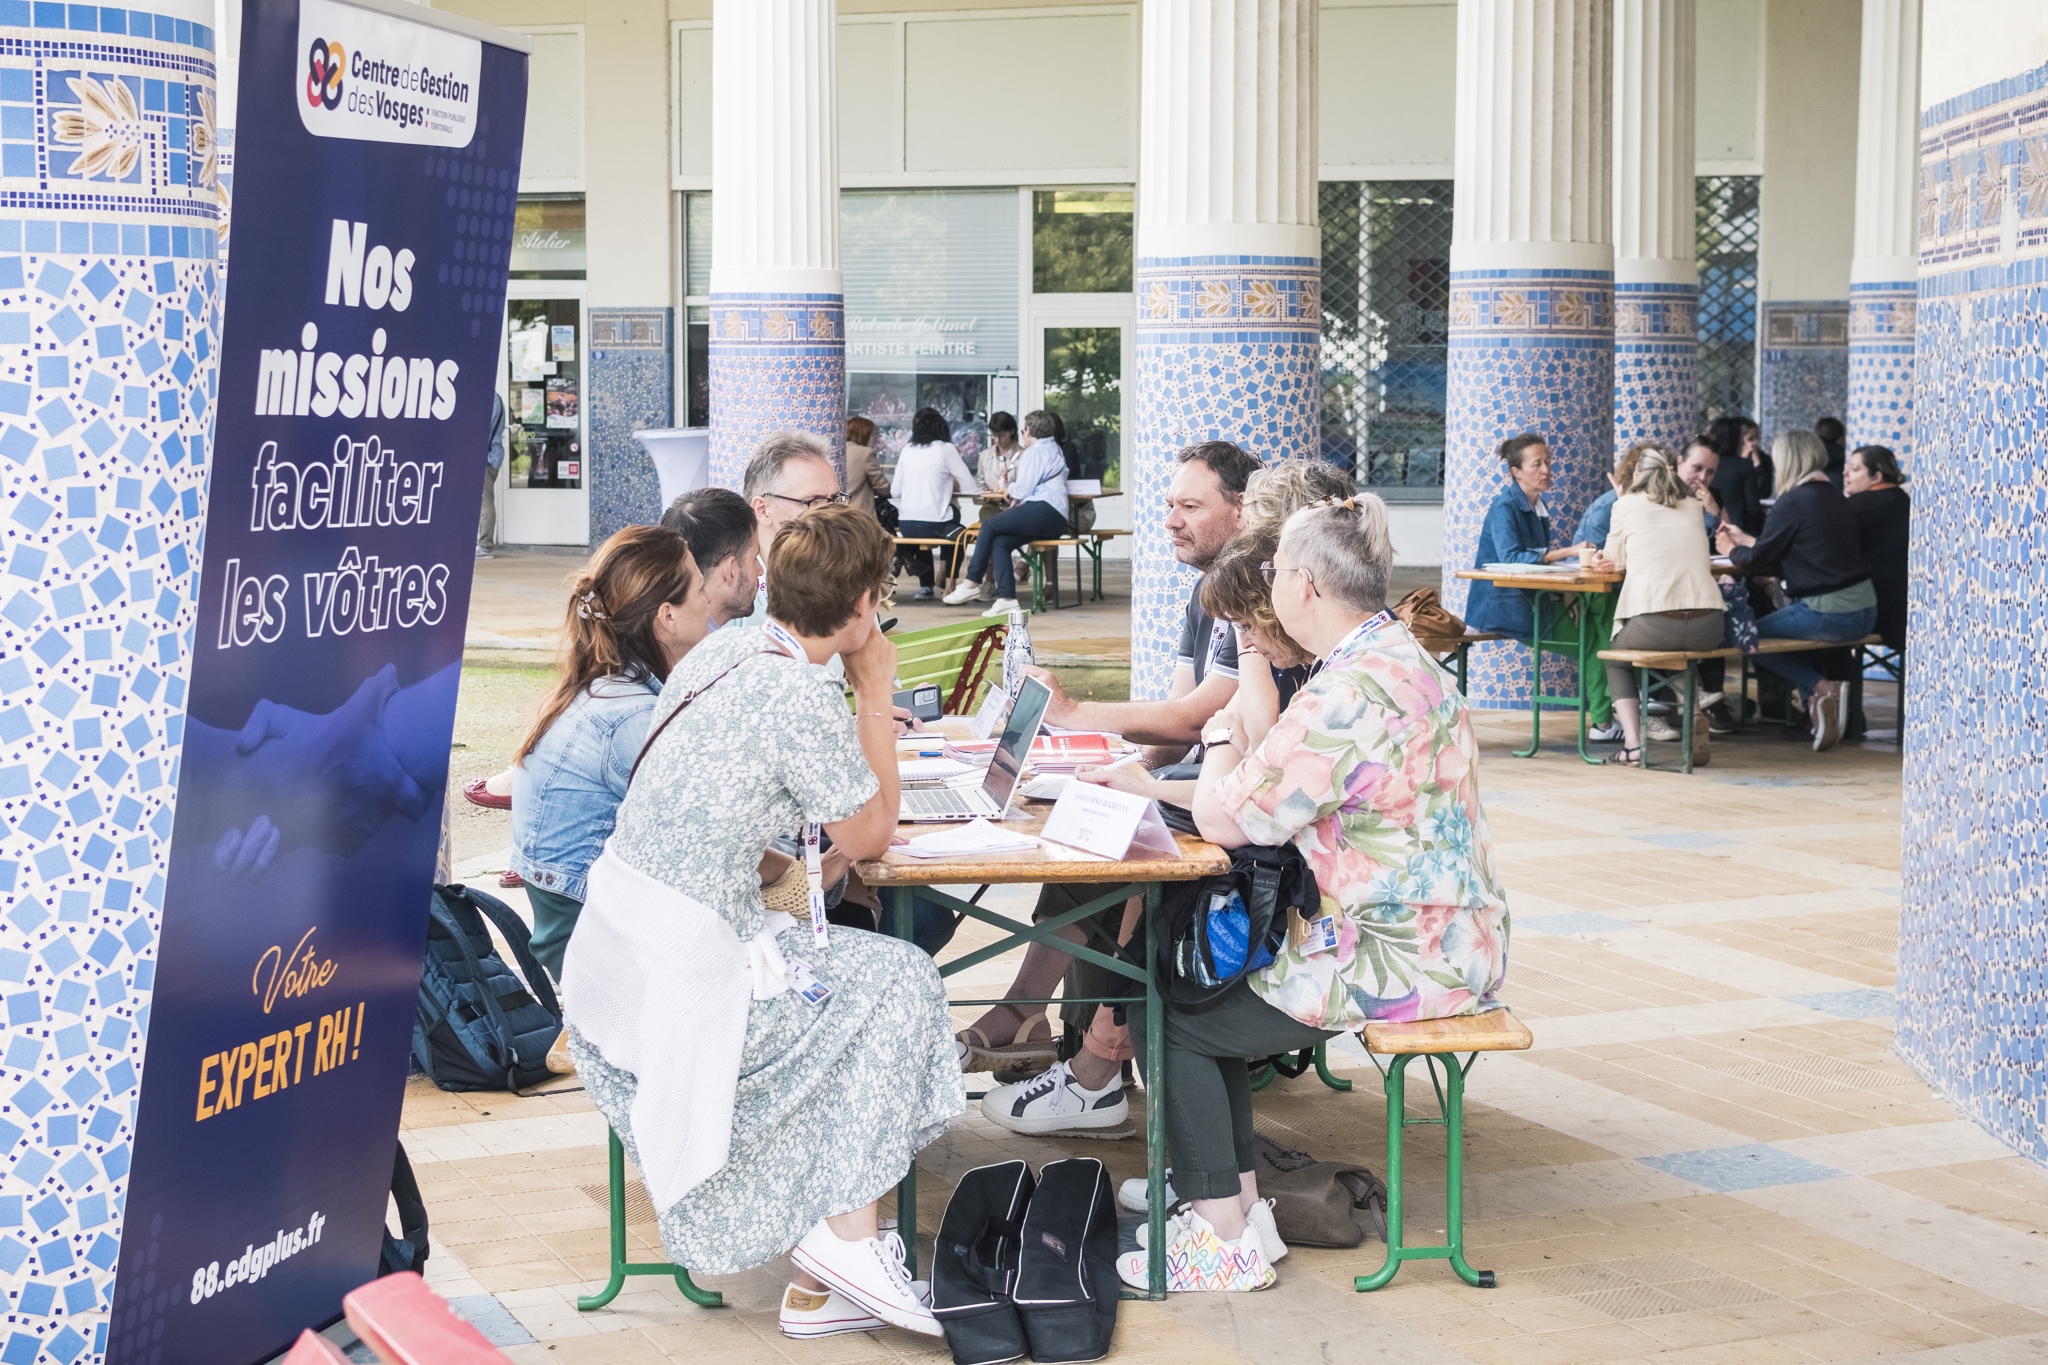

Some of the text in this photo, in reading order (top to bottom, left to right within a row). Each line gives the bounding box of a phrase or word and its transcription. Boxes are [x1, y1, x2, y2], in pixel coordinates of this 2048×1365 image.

[348, 86, 424, 129] des Vosges
[351, 50, 469, 103] Centre de Gestion
[324, 218, 416, 312] Nos
[517, 231, 571, 250] Atelier
[255, 321, 459, 421] missions
[845, 342, 976, 355] ARTISTE PEINTRE
[250, 435, 444, 533] faciliter
[217, 546, 450, 650] les vôtres
[251, 925, 339, 1014] Votre
[195, 1002, 366, 1122] EXPERT RH !
[190, 1210, 327, 1305] 88.cdgplus.fr
